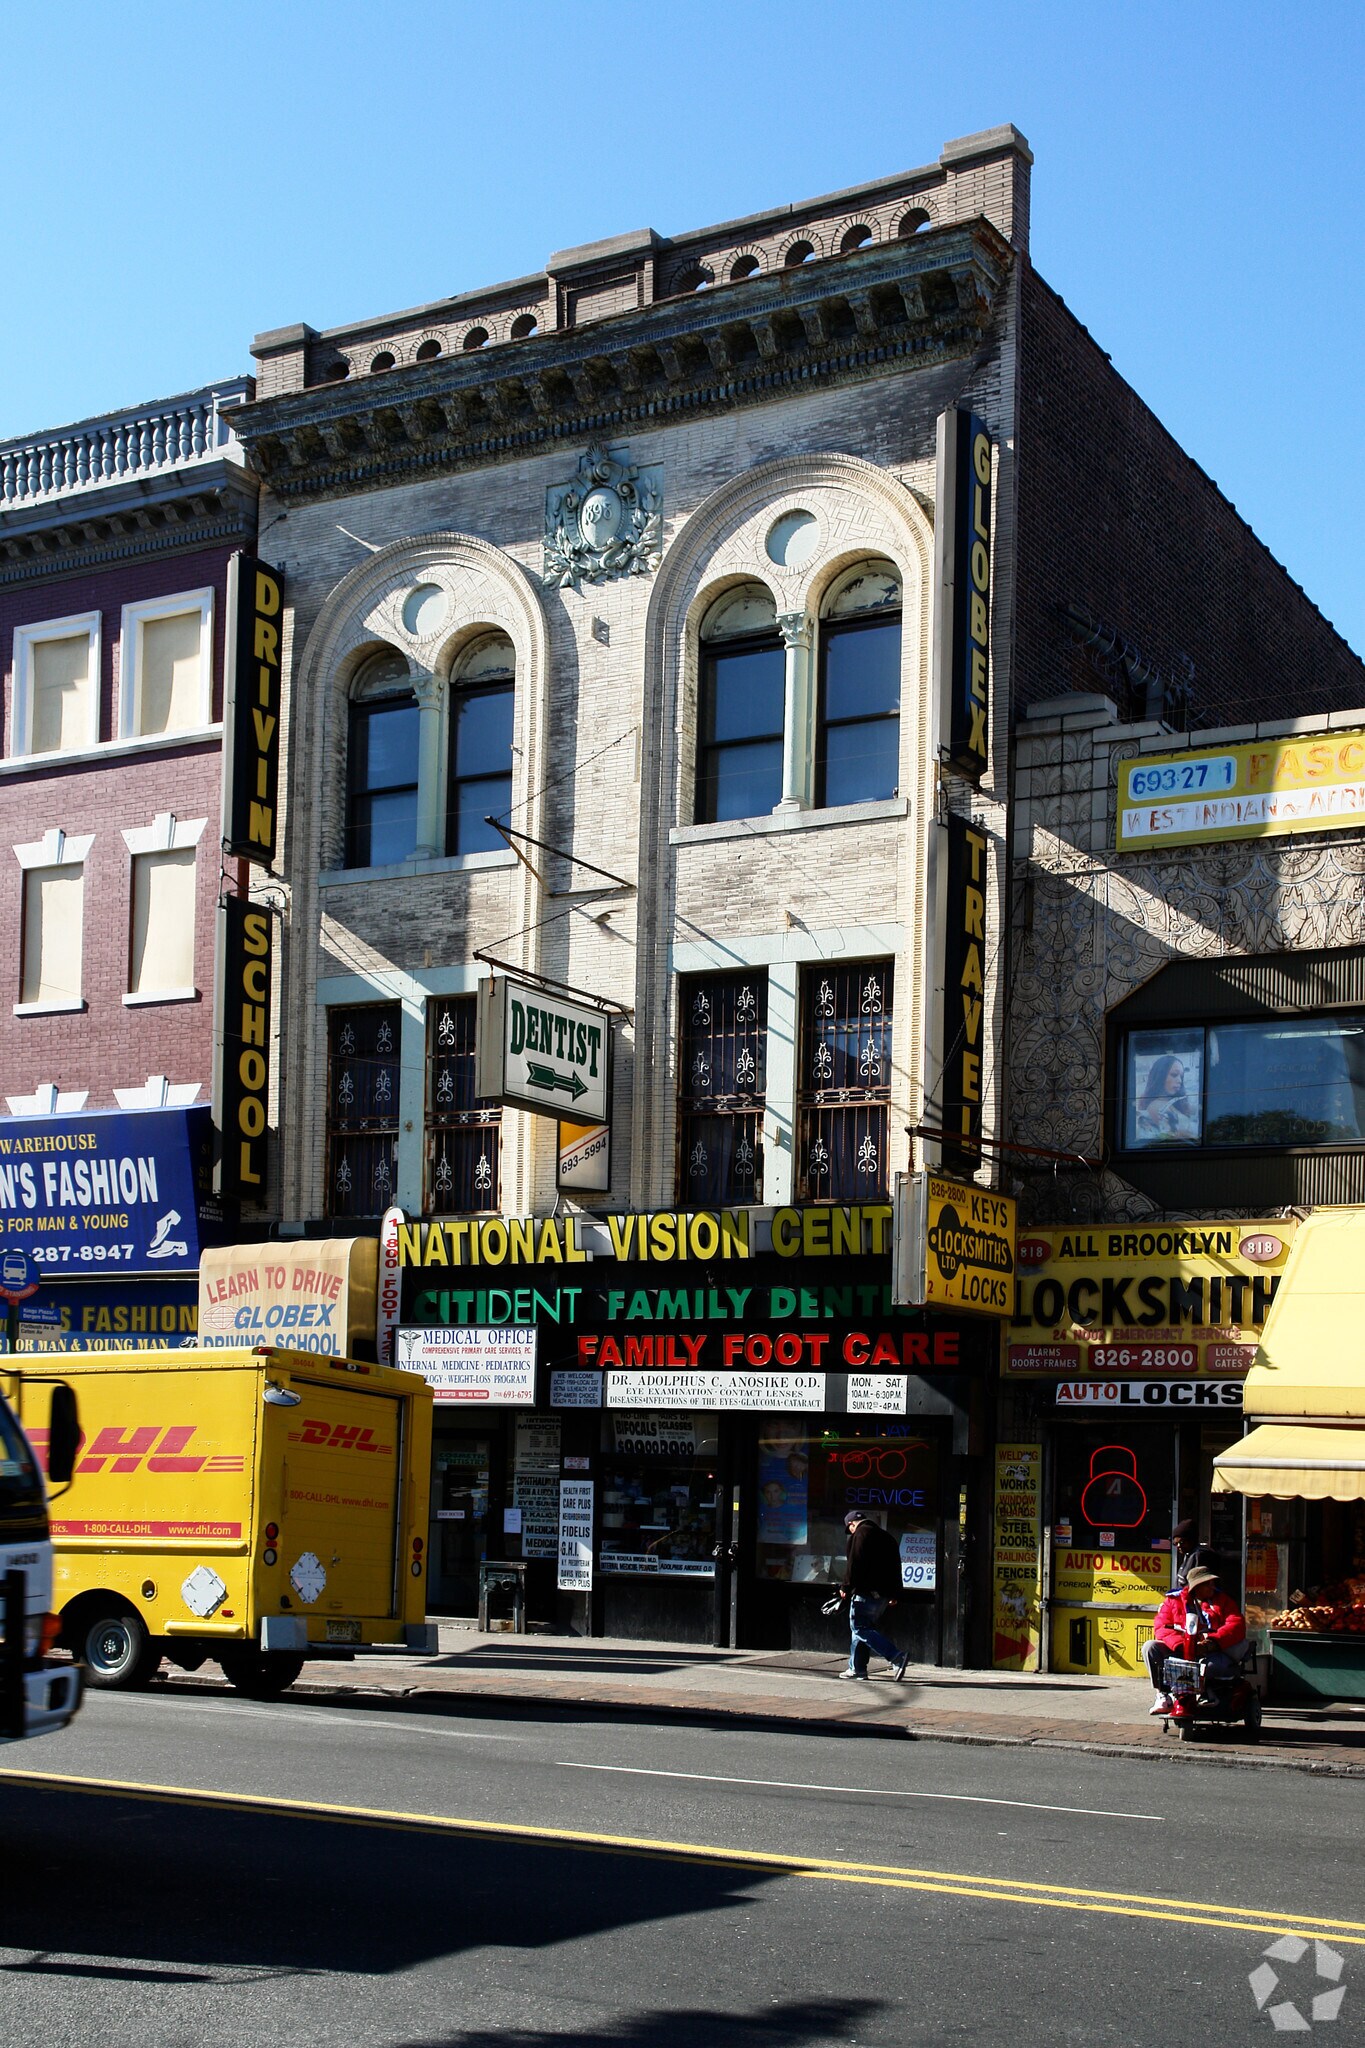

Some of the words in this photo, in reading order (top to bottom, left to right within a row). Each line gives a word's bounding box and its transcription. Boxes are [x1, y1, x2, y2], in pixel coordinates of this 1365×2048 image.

[968, 432, 991, 760] GLOBEX
[248, 570, 281, 848] DRIVIN
[1195, 797, 1278, 826] INDIAN
[960, 828, 986, 1157] TRAVEL
[511, 998, 601, 1079] DENTIST
[239, 912, 268, 1187] SCHOOL
[0, 1133, 97, 1155] WAREHOUSE
[561, 1136, 607, 1175] 693-5994
[42, 1156, 159, 1208] FASHION
[930, 1181, 967, 1204] 826-2800
[970, 1194, 1008, 1228] KEYS
[8, 1217, 34, 1233] FOR
[36, 1215, 66, 1232] MAN
[69, 1214, 79, 1231] &
[82, 1212, 130, 1230] YOUNG
[397, 1215, 590, 1268] NATIONAL
[607, 1210, 751, 1264] VISION
[1020, 1246, 1044, 1259] 818
[1059, 1235, 1099, 1258] ALL
[1107, 1231, 1232, 1257] BROOKLYN
[1246, 1241, 1273, 1255] 818
[937, 1228, 1008, 1266] LOCKSMITHS
[941, 1254, 957, 1271] LTD.
[206, 1268, 260, 1305] LEARN
[265, 1265, 287, 1290] TO
[292, 1267, 344, 1301] DRIVE
[961, 1273, 1007, 1307] LOCKS
[414, 1287, 583, 1325] CITIDENT
[607, 1286, 753, 1321] FAMILY
[1010, 1274, 1282, 1328] LOCKSMITH
[82, 1304, 198, 1334] FASHION
[233, 1302, 337, 1330] GLOBEX
[422, 1330, 481, 1345] MEDICAL
[488, 1329, 534, 1345] OFFICE
[1052, 1328, 1068, 1341] 24
[1072, 1327, 1106, 1341] HOUR
[1112, 1327, 1186, 1341] EMERGENCY
[1191, 1326, 1242, 1341] SERVICE
[37, 1338, 68, 1352] MAN
[70, 1337, 81, 1351] &
[84, 1337, 134, 1352] YOUNG
[136, 1337, 170, 1352] MAN
[275, 1332, 341, 1356] SCHOOL
[421, 1346, 460, 1355] COMPREHENSIVE
[461, 1346, 483, 1355] PRIMARY
[484, 1346, 497, 1355] CARE
[577, 1334, 708, 1368] FAMILY
[722, 1333, 831, 1367] FOOT
[842, 1332, 961, 1366] CARE
[1027, 1347, 1061, 1358] ALARMS
[1093, 1348, 1194, 1368] 826-2800
[1215, 1347, 1246, 1358] LOCKS
[397, 1360, 438, 1371] INTERNAL
[441, 1360, 480, 1371] MEDICINE
[485, 1360, 531, 1371] PEDIATRICS
[1214, 1358, 1243, 1369] GATES
[447, 1374, 491, 1384] WEIGHT-LOSS
[493, 1374, 527, 1384] PROGRAM
[611, 1374, 632, 1387] DR.
[637, 1375, 706, 1388] ADOLPHUS
[711, 1376, 723, 1388] C.
[729, 1376, 789, 1389] ANOSIKE
[794, 1377, 821, 1390] O.D.
[851, 1377, 874, 1388] MON.
[885, 1378, 904, 1389] SAT.
[503, 1390, 532, 1399] 693-6795
[626, 1387, 644, 1396] EYE
[648, 1388, 714, 1397] EXAMINATION
[719, 1389, 762, 1398] CONTACT
[765, 1389, 804, 1398] LENSES
[1056, 1382, 1119, 1401] AUTO
[689, 1397, 699, 1406] OF
[702, 1397, 717, 1406] THE
[299, 1419, 378, 1453] DHL
[615, 1421, 657, 1437] BIFOCALS
[562, 1487, 578, 1496] HEALTH
[579, 1487, 592, 1496] FIRST
[999, 1478, 1037, 1490] WORKS
[341, 1496, 389, 1510] www.dhl.com
[562, 1498, 576, 1509] CARE
[577, 1498, 591, 1510] PLUS
[845, 1486, 928, 1508] SERVICE
[999, 1494, 1037, 1506] WINDOW
[83, 1523, 153, 1534] 1-800-CALL-DHL
[168, 1524, 232, 1536] www.dhl.com
[562, 1525, 591, 1538] FIDELIS
[1002, 1522, 1034, 1535] STEEL
[561, 1541, 580, 1557] G.H.I.
[1000, 1535, 1036, 1548] DOORS
[996, 1551, 1038, 1563] RAILINGS
[1064, 1552, 1104, 1571] AUTO
[1111, 1554, 1162, 1574] LOCKS
[560, 1569, 574, 1578] DAVIS
[575, 1570, 590, 1579] VISION
[660, 1562, 684, 1571] ADOLPHUS
[903, 1565, 925, 1584] 99
[996, 1567, 1038, 1579] FENCES
[559, 1578, 577, 1588] METRO
[578, 1579, 591, 1588] PLUS
[1057, 1580, 1091, 1590] FOREIGN
[1127, 1584, 1168, 1593] DOMESTIC
